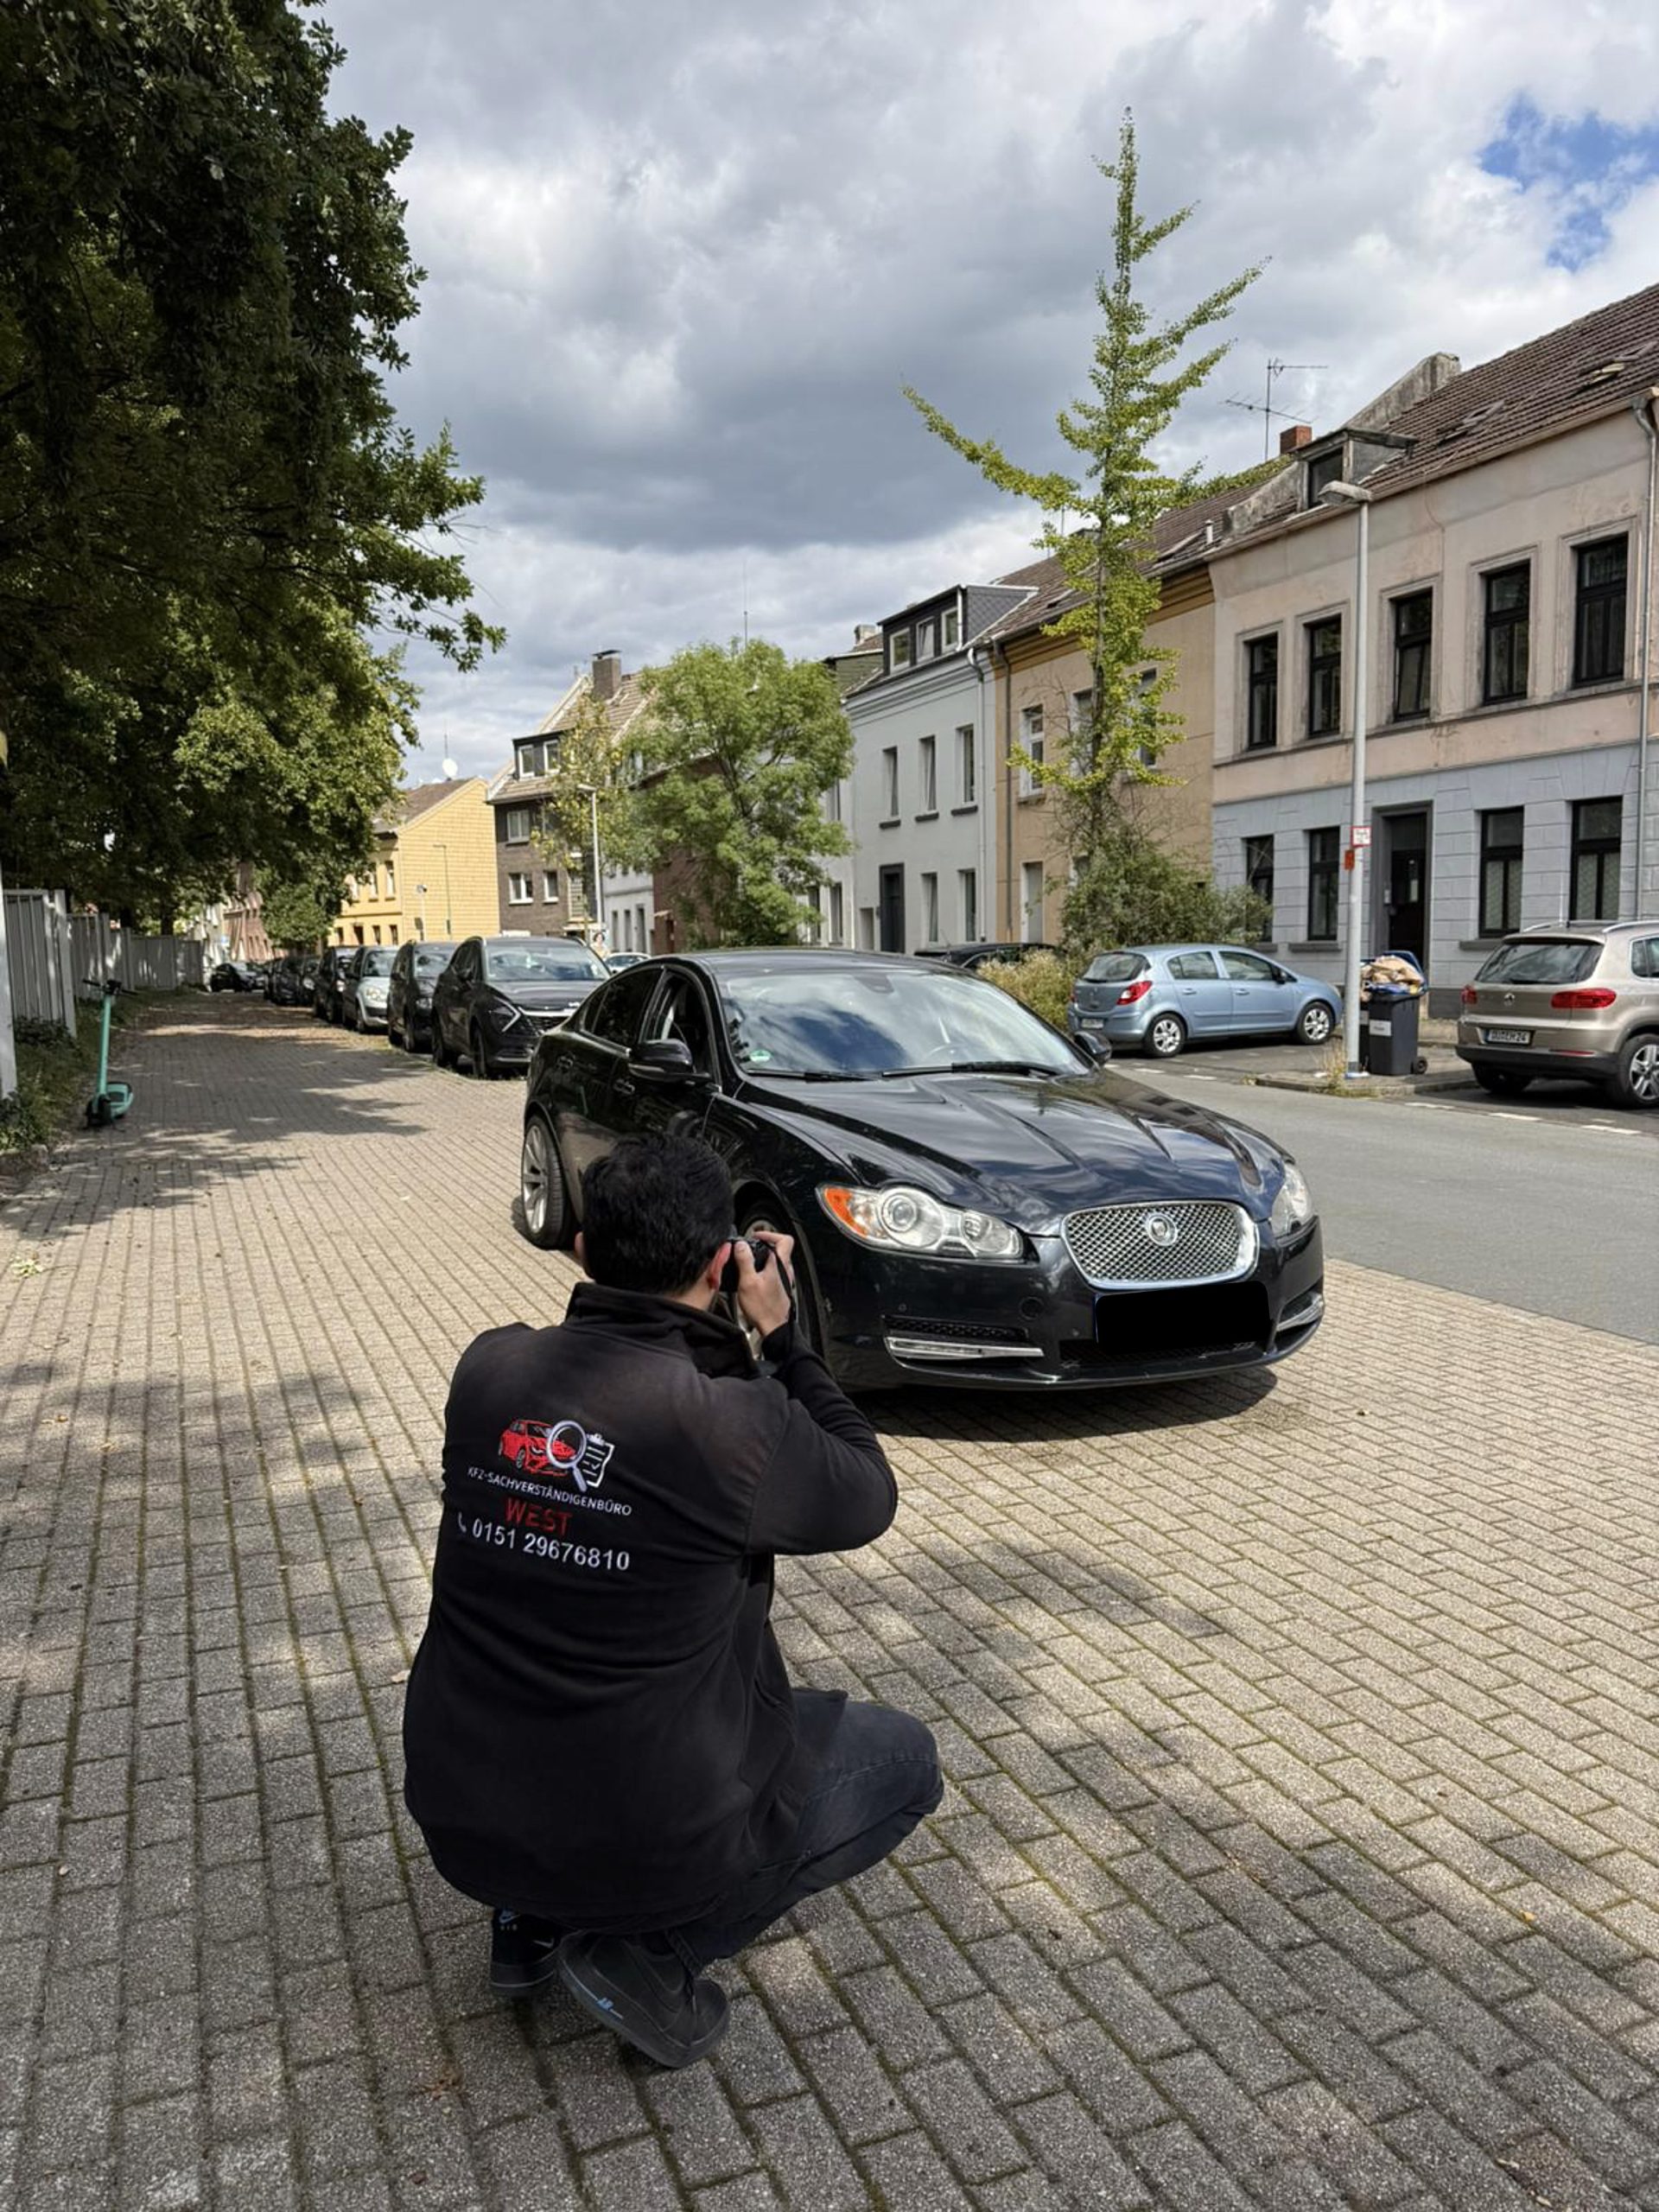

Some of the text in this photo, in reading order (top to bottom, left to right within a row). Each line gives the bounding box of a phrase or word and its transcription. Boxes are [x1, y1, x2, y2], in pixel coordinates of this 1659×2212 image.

[467, 1466, 632, 1516] KFZ-SACHVERSTÄNDIGENBÜRO
[505, 1497, 573, 1536] WEST
[472, 1517, 631, 1571] 0151 29676810
